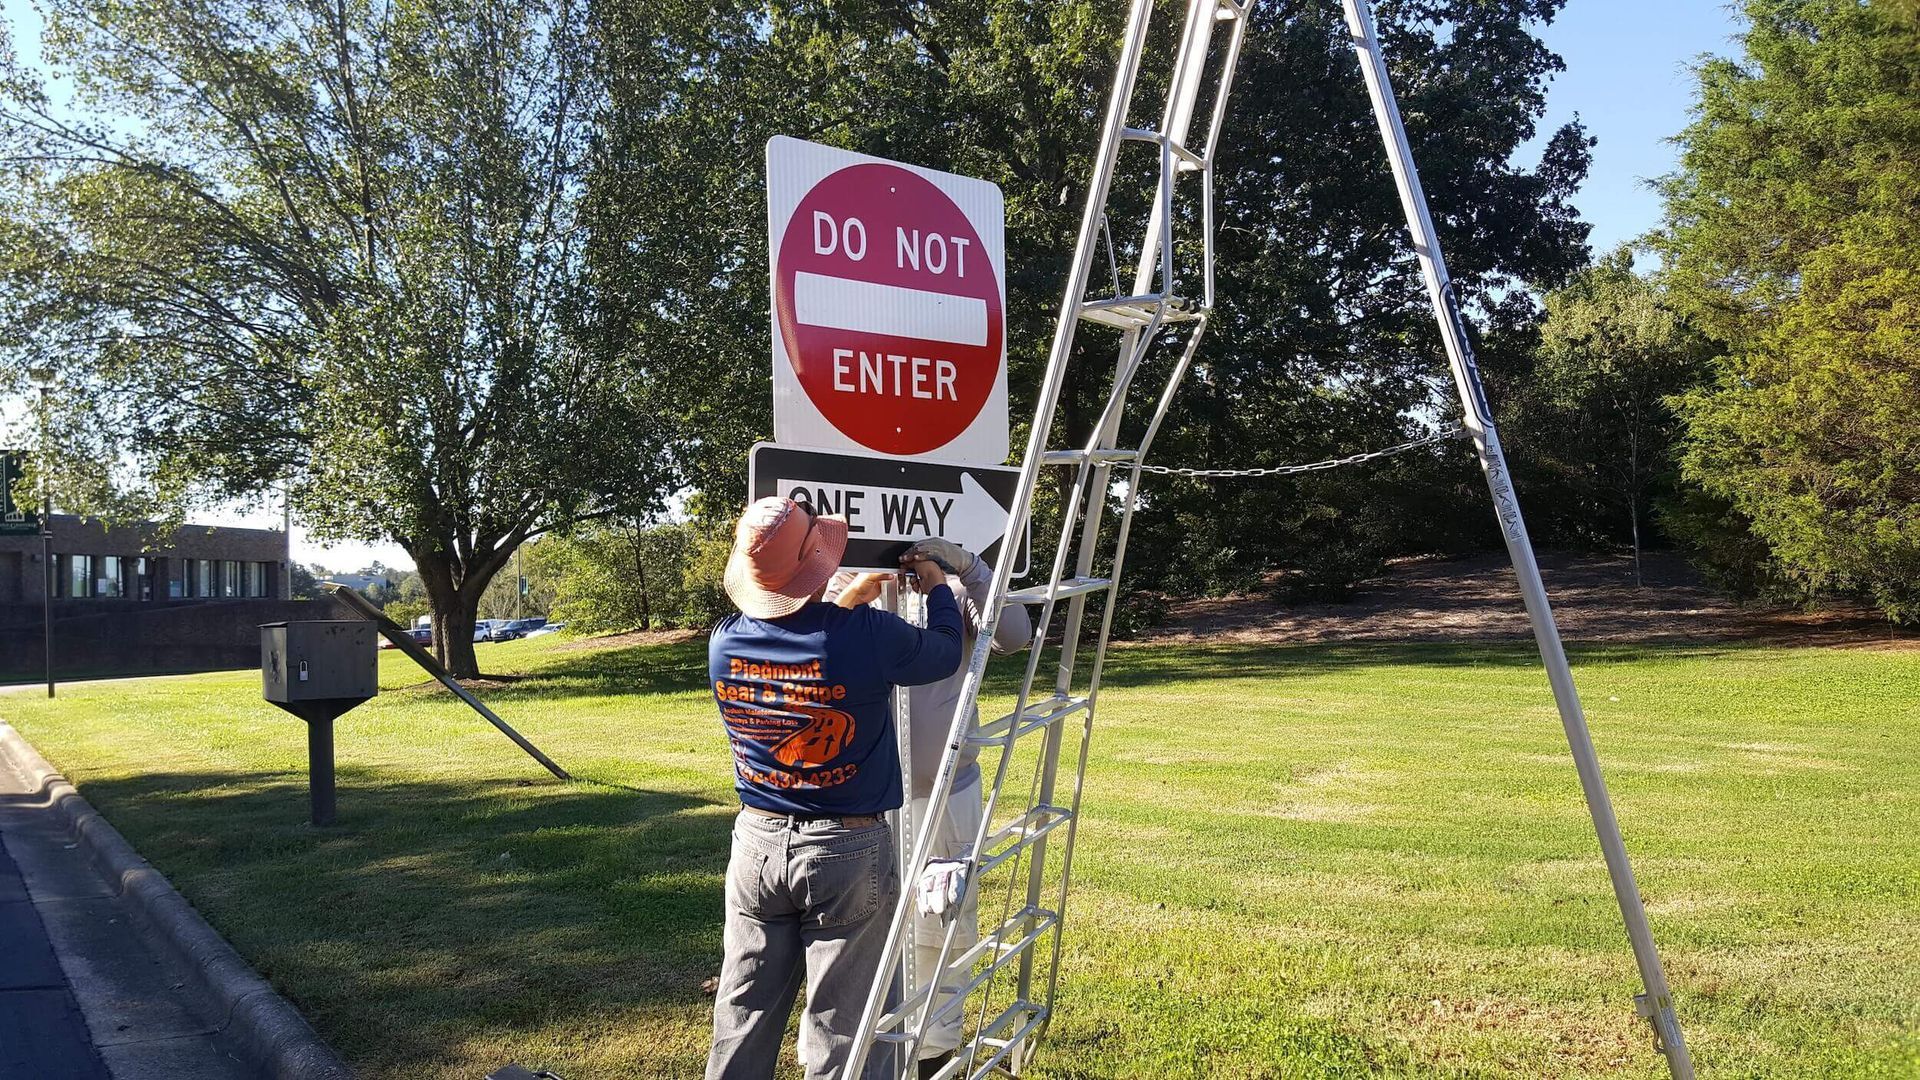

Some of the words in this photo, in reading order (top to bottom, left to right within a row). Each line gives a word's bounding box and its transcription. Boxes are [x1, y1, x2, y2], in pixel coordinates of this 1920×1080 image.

[813, 210, 867, 262] DO
[896, 227, 970, 278] NOT
[833, 348, 958, 402] ENTER
[881, 493, 954, 537] WAY
[729, 658, 823, 681] Piedmont
[782, 682, 847, 706] Stripe
